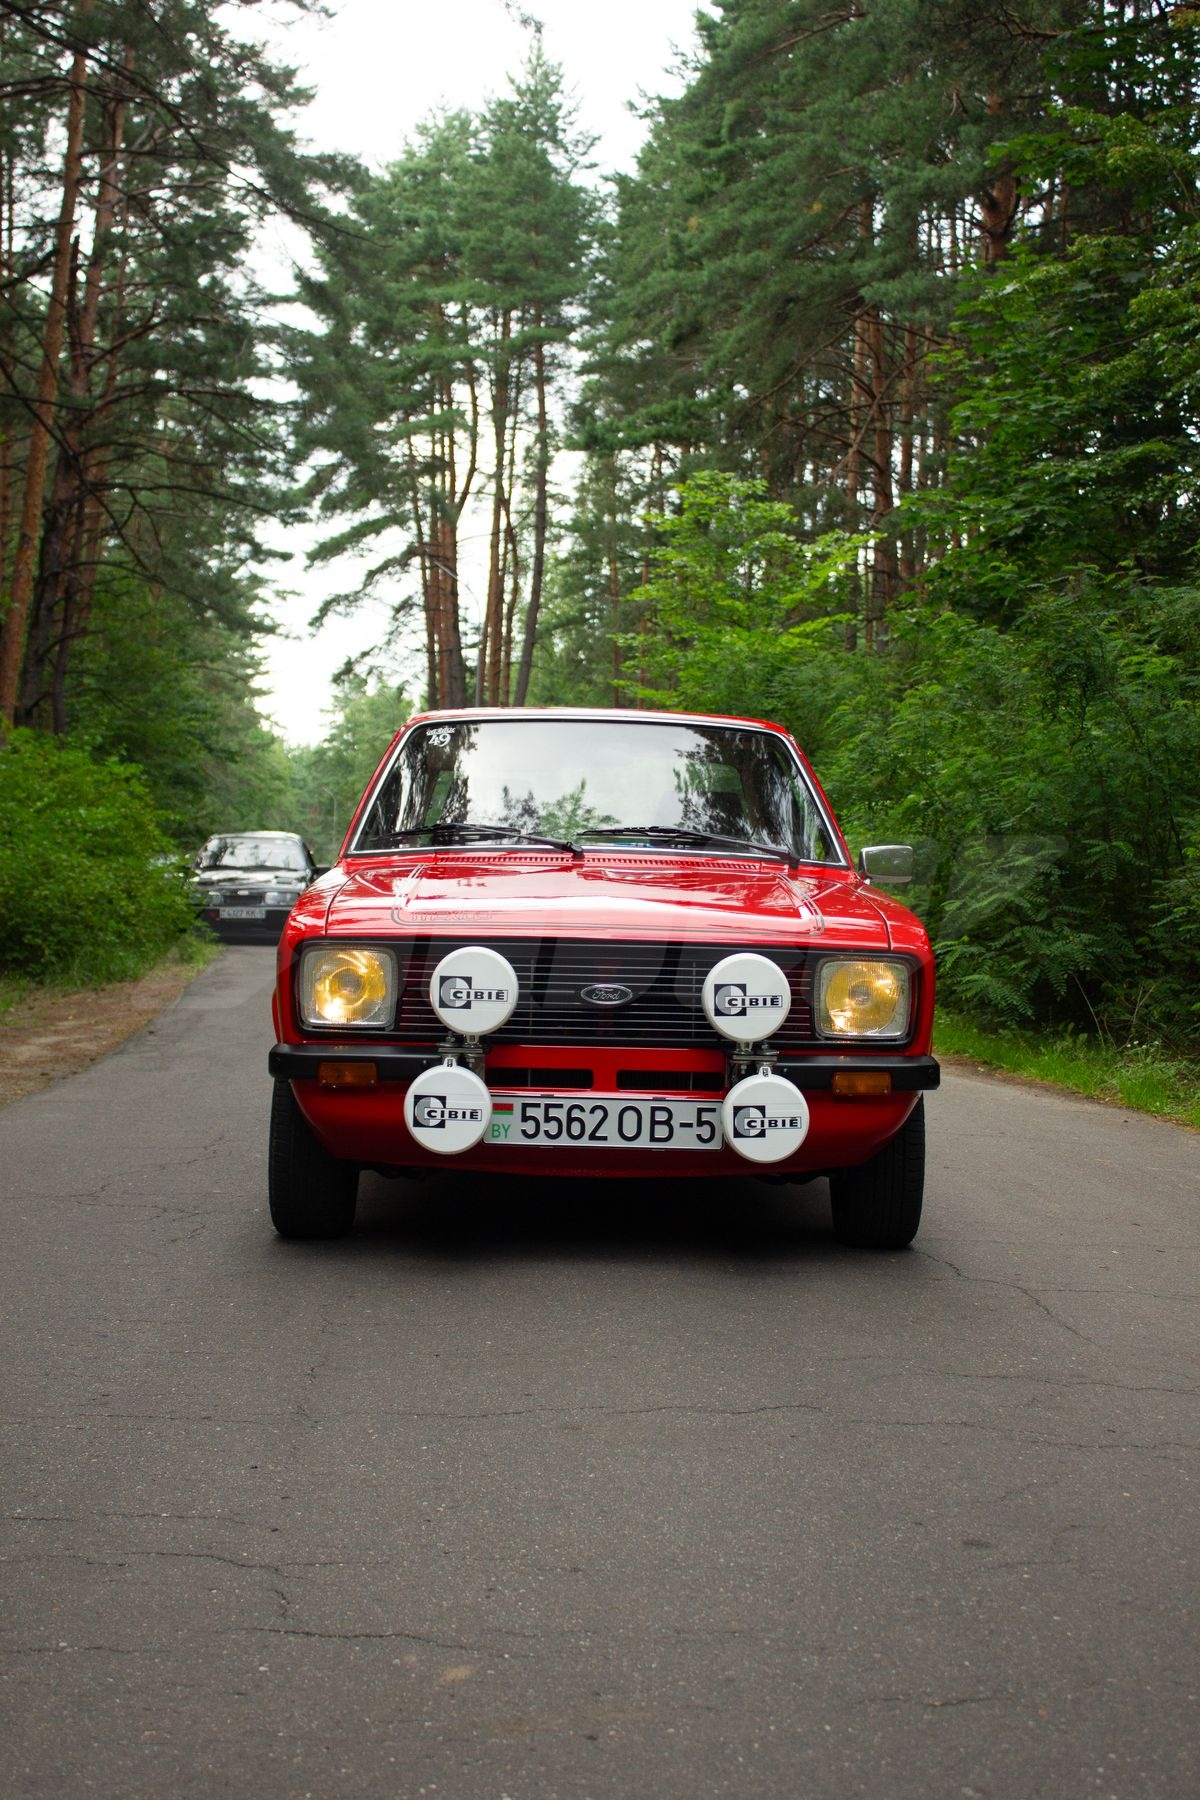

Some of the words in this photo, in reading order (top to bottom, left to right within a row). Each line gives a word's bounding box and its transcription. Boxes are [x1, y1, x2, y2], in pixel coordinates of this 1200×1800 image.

[592, 987, 621, 1000] Ford
[491, 1123, 511, 1139] BY
[520, 1102, 609, 1141] 5562
